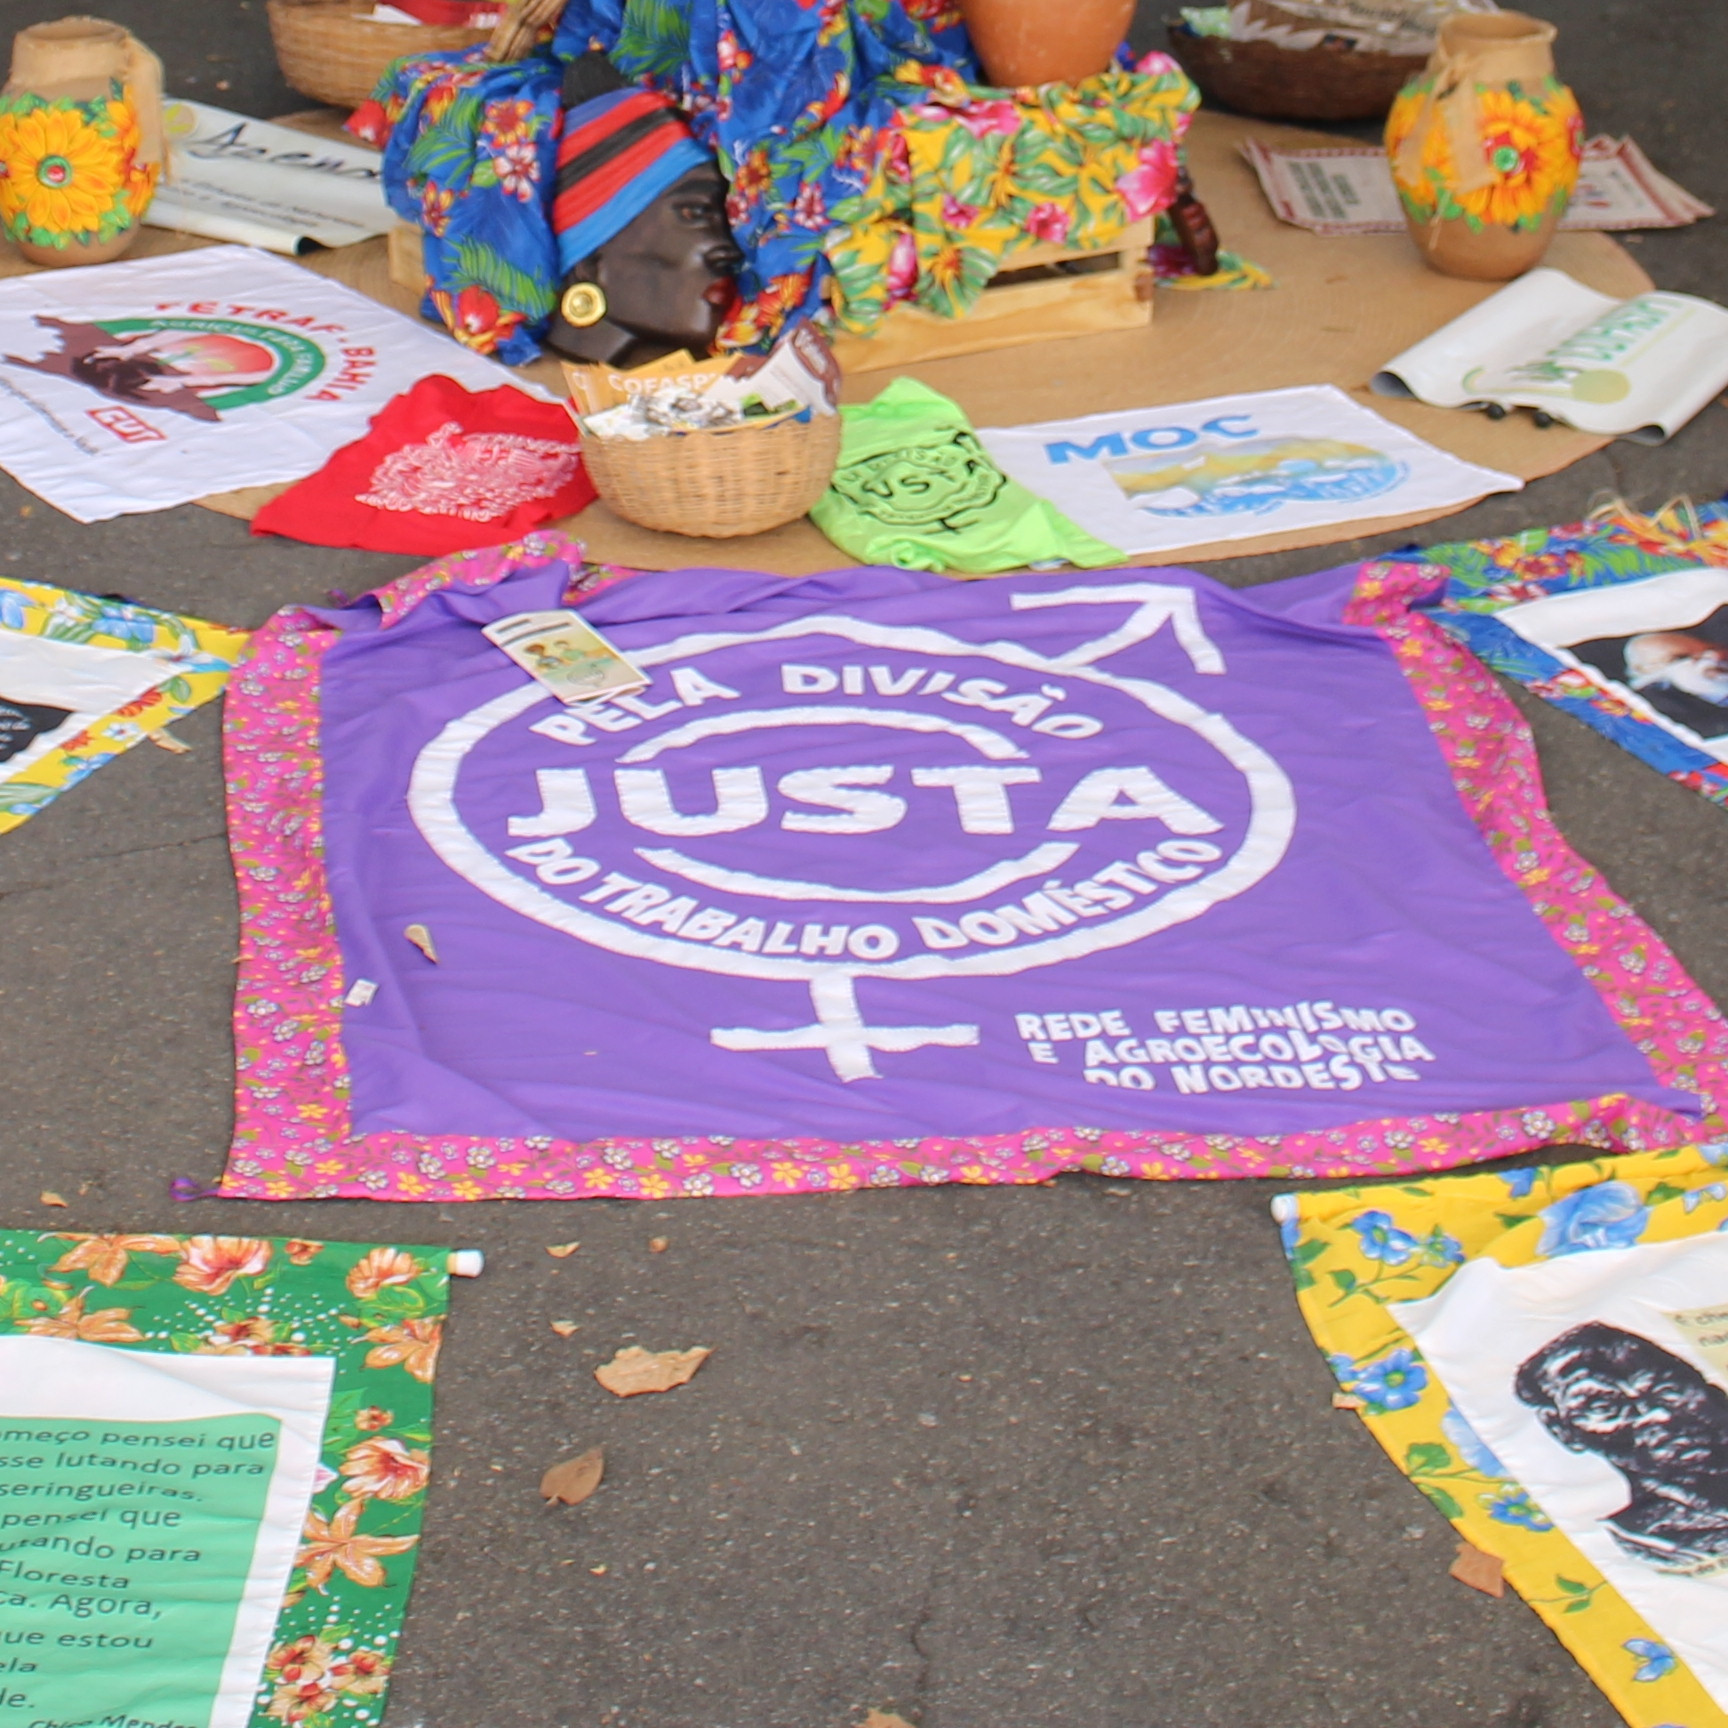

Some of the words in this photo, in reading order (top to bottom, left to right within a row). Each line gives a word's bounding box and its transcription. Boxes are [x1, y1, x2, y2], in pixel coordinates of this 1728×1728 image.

[304, 346, 378, 401] BAHIA
[607, 372, 723, 396] COFASP
[1043, 414, 1261, 466] MOC
[528, 665, 742, 747] PELA
[780, 663, 1105, 740] DIVISÃO
[506, 764, 1226, 838] JUSTA
[503, 837, 601, 886] DO
[578, 872, 901, 962] TRABALHO
[910, 838, 1224, 951] DOMÉSTCO
[1014, 1009, 1132, 1042] REDE
[1153, 1000, 1417, 1036] FEMINISMO
[1026, 1041, 1060, 1065] E
[1083, 1028, 1437, 1069] AGROECOLOGIA
[1082, 1067, 1158, 1092] DO
[1169, 1055, 1422, 1095] NORDESTE
[100, 1429, 208, 1450] pensei
[216, 1430, 276, 1453] que
[55, 1450, 183, 1476] lutando
[190, 1461, 267, 1481] para
[0, 1506, 109, 1531] pensei
[119, 1508, 184, 1531] que
[124, 1546, 203, 1565] para
[48, 1592, 163, 1621] Agora,
[56, 1631, 155, 1650] estou
